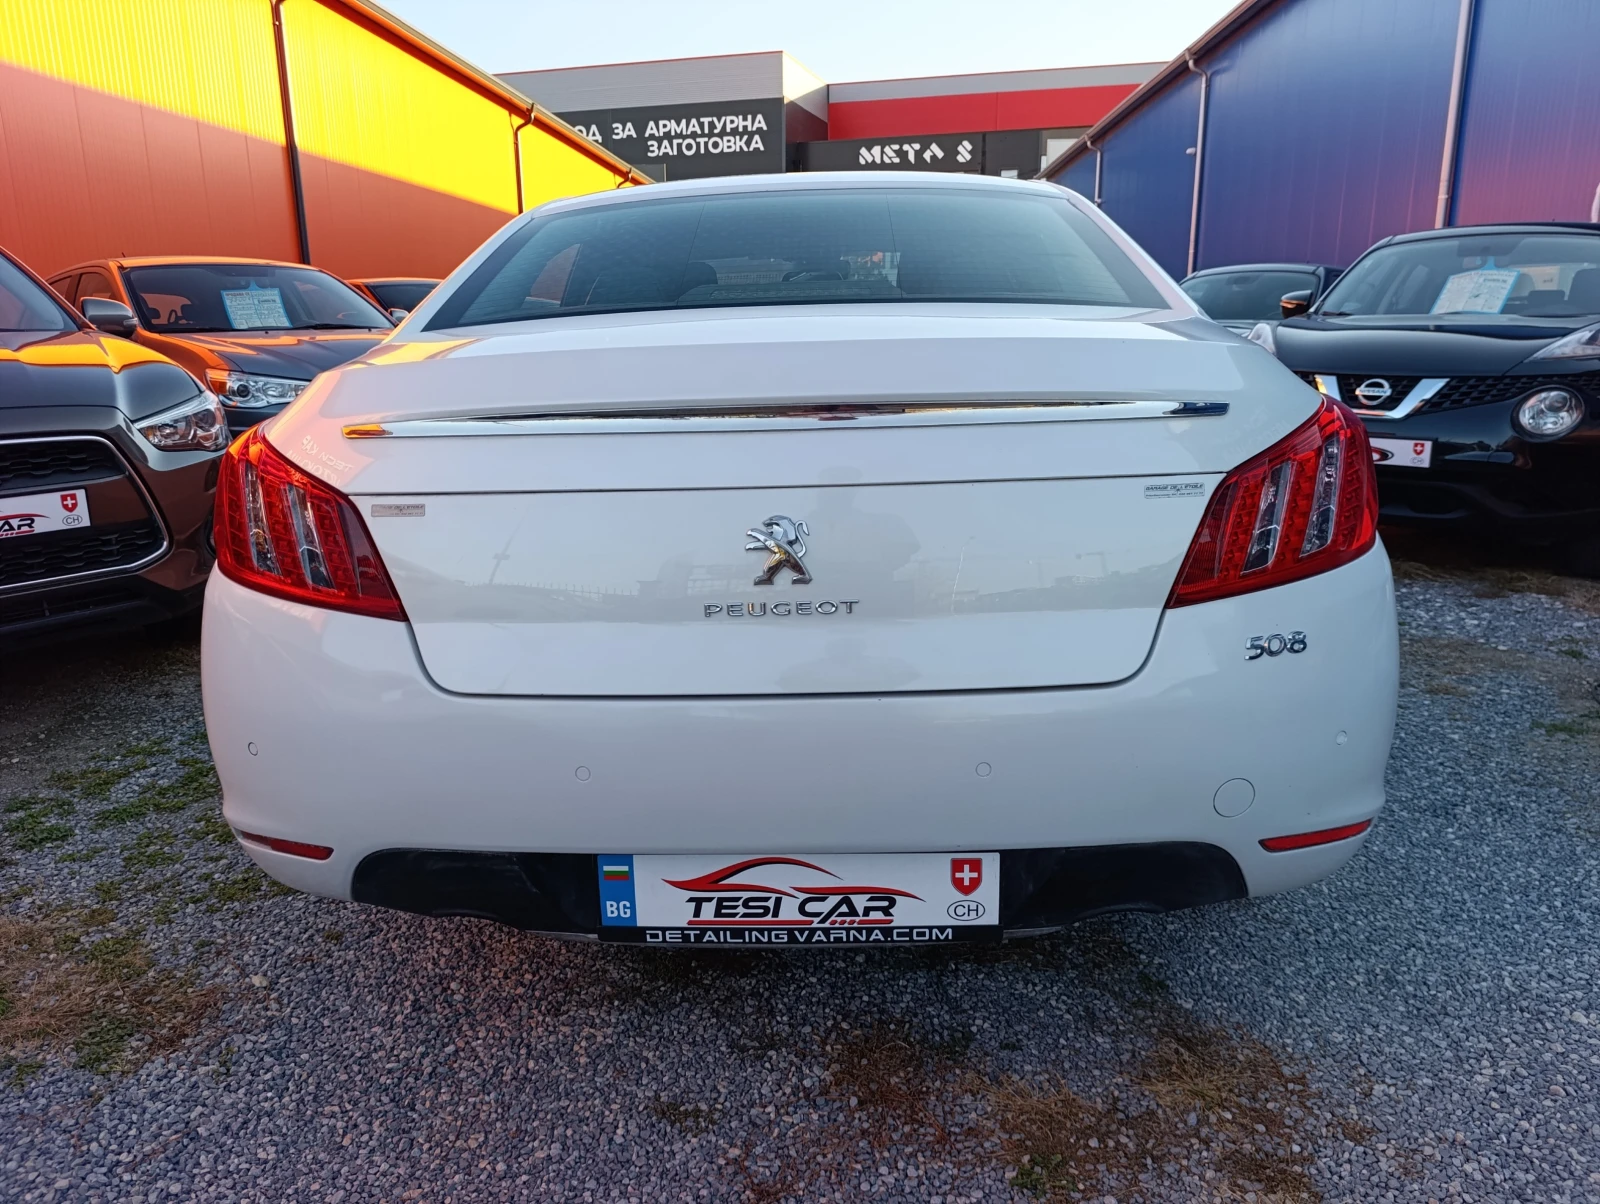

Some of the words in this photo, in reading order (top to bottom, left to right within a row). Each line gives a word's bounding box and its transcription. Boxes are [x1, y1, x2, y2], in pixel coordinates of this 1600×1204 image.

[612, 122, 637, 140] ЗА
[644, 114, 768, 138] АРМАТУРНА
[647, 135, 765, 158] ЗАГОТОВКА
[65, 516, 80, 525] CH
[704, 599, 860, 618] PEUGEOT
[1244, 630, 1308, 661] 508
[606, 900, 631, 918] BG
[685, 896, 783, 919] TESI
[797, 895, 897, 925] CAR
[953, 904, 980, 918] CH
[646, 928, 953, 943] DETAILINGVARNA.COM
